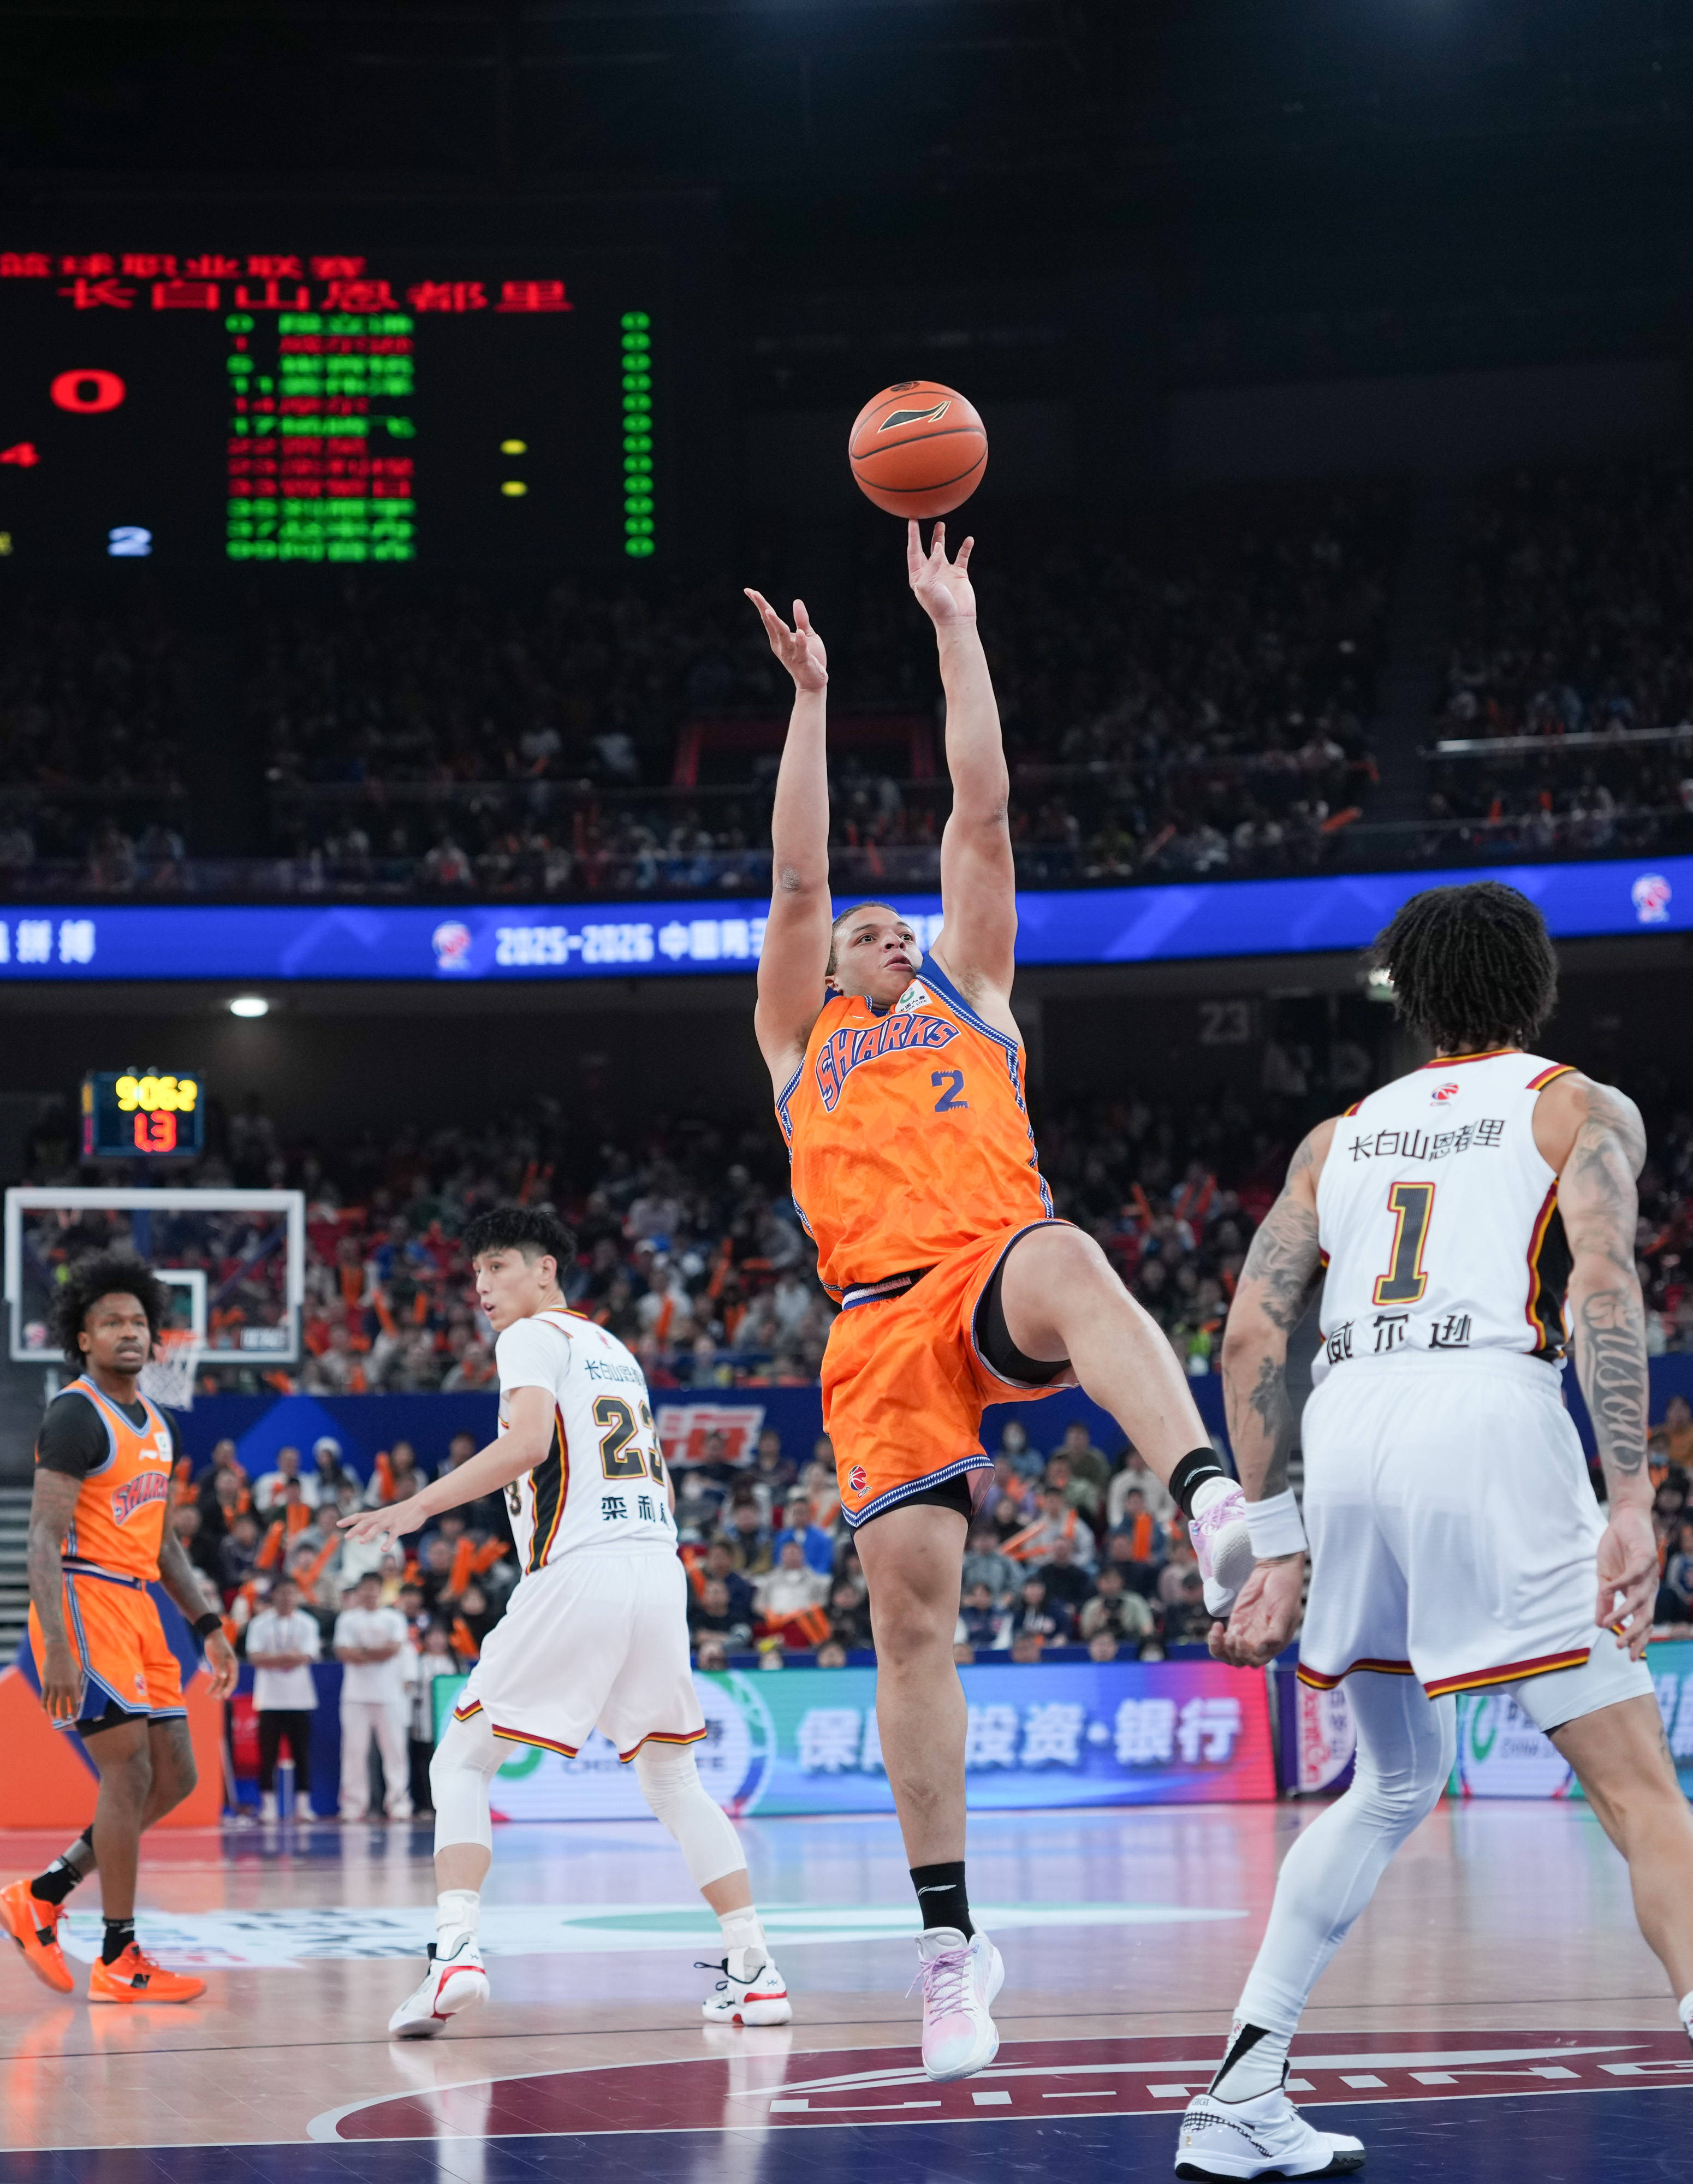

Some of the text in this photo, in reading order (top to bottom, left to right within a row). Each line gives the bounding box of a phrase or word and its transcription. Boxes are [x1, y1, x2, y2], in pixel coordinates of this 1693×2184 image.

[51, 369, 126, 413] 0
[108, 526, 152, 556] 2
[815, 1013, 961, 1113] SHARKS
[931, 1070, 969, 1112] 2
[1349, 1119, 1506, 1162] 长白山恩都里
[1373, 1182, 1435, 1305] 1
[1192, 2098, 1209, 2106] GIGI
